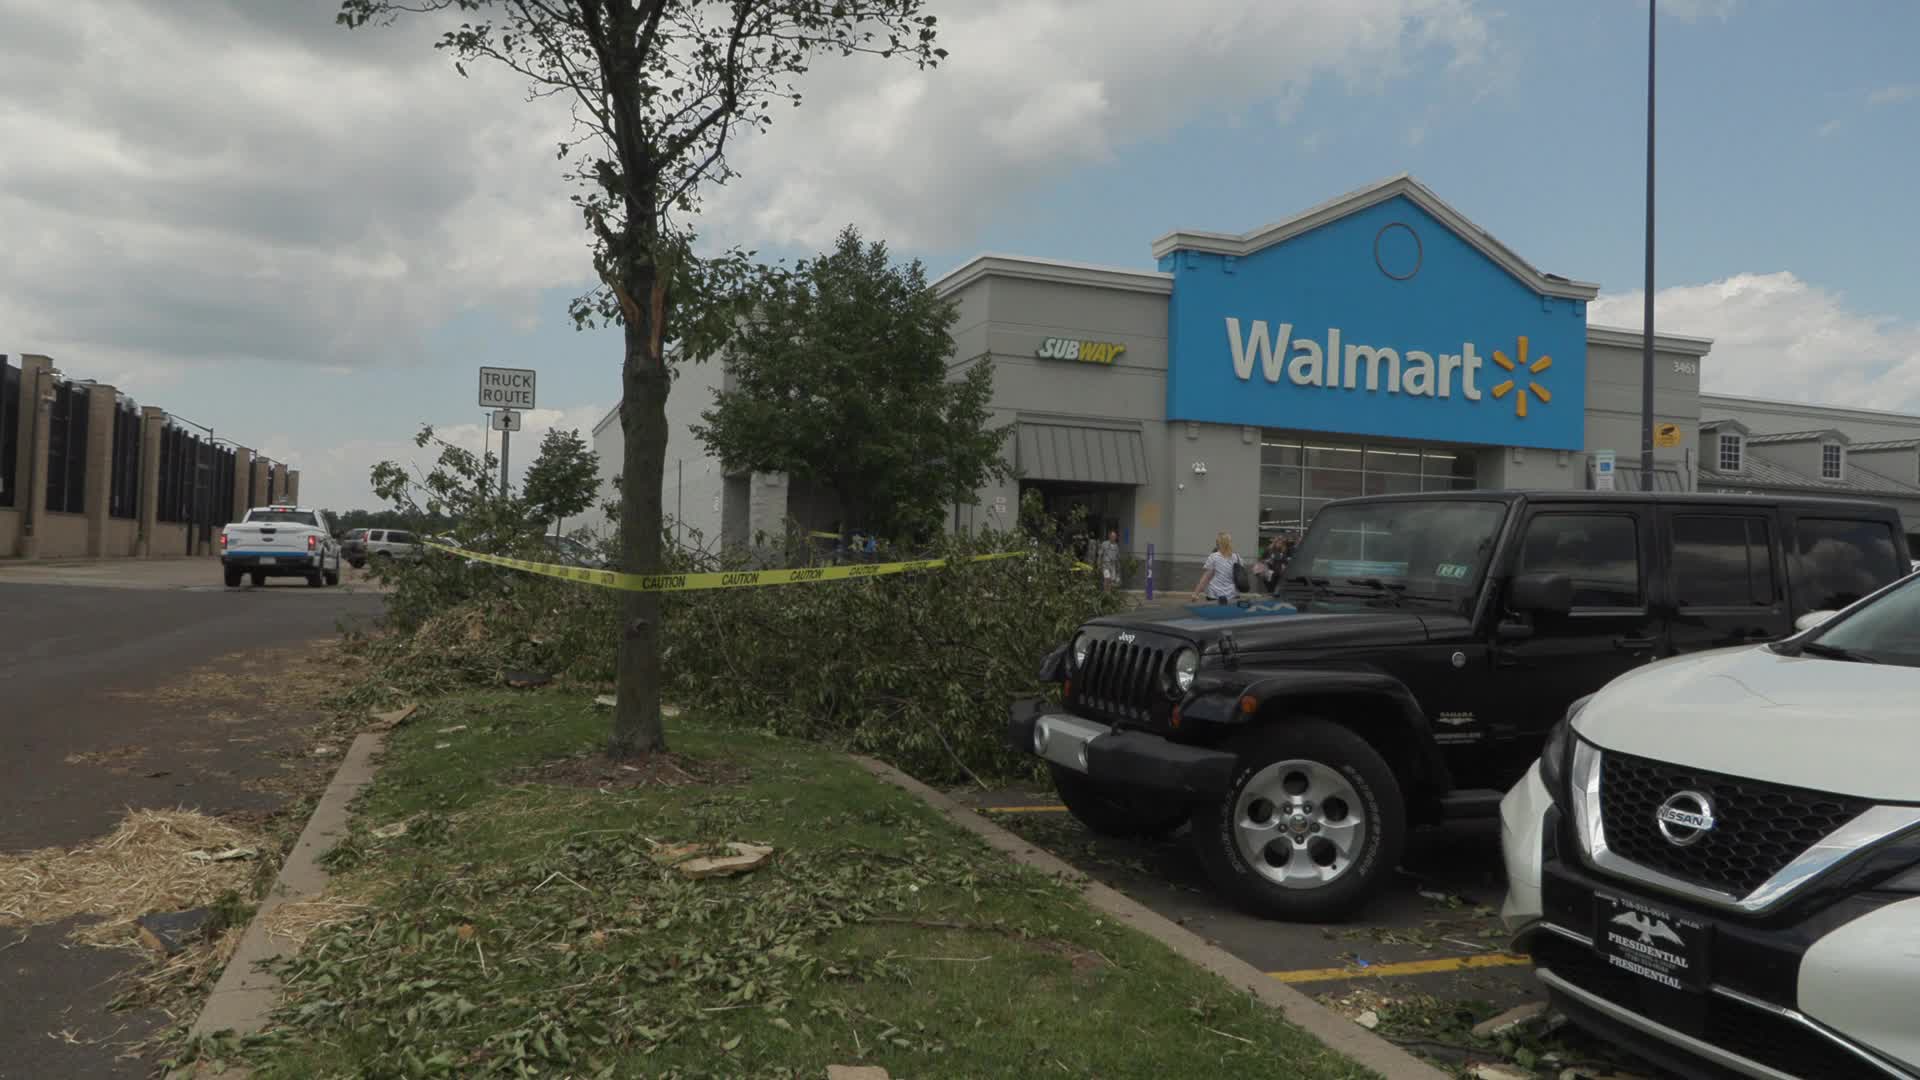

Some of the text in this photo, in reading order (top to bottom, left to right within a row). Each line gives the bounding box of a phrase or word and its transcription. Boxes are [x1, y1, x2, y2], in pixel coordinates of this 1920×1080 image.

[1039, 338, 1125, 363] SUBWAY
[1225, 317, 1482, 400] Walmart
[483, 373, 532, 388] TRUCK
[483, 389, 530, 404] ROUTE
[642, 576, 686, 589] CAUTION
[721, 573, 759, 585] CAUTION
[789, 569, 824, 581] CAUTION
[1659, 806, 1704, 826] NISSAN
[1607, 931, 1689, 969] PRESIDENTIAL
[1609, 953, 1683, 990] PRESIDENTIAL
